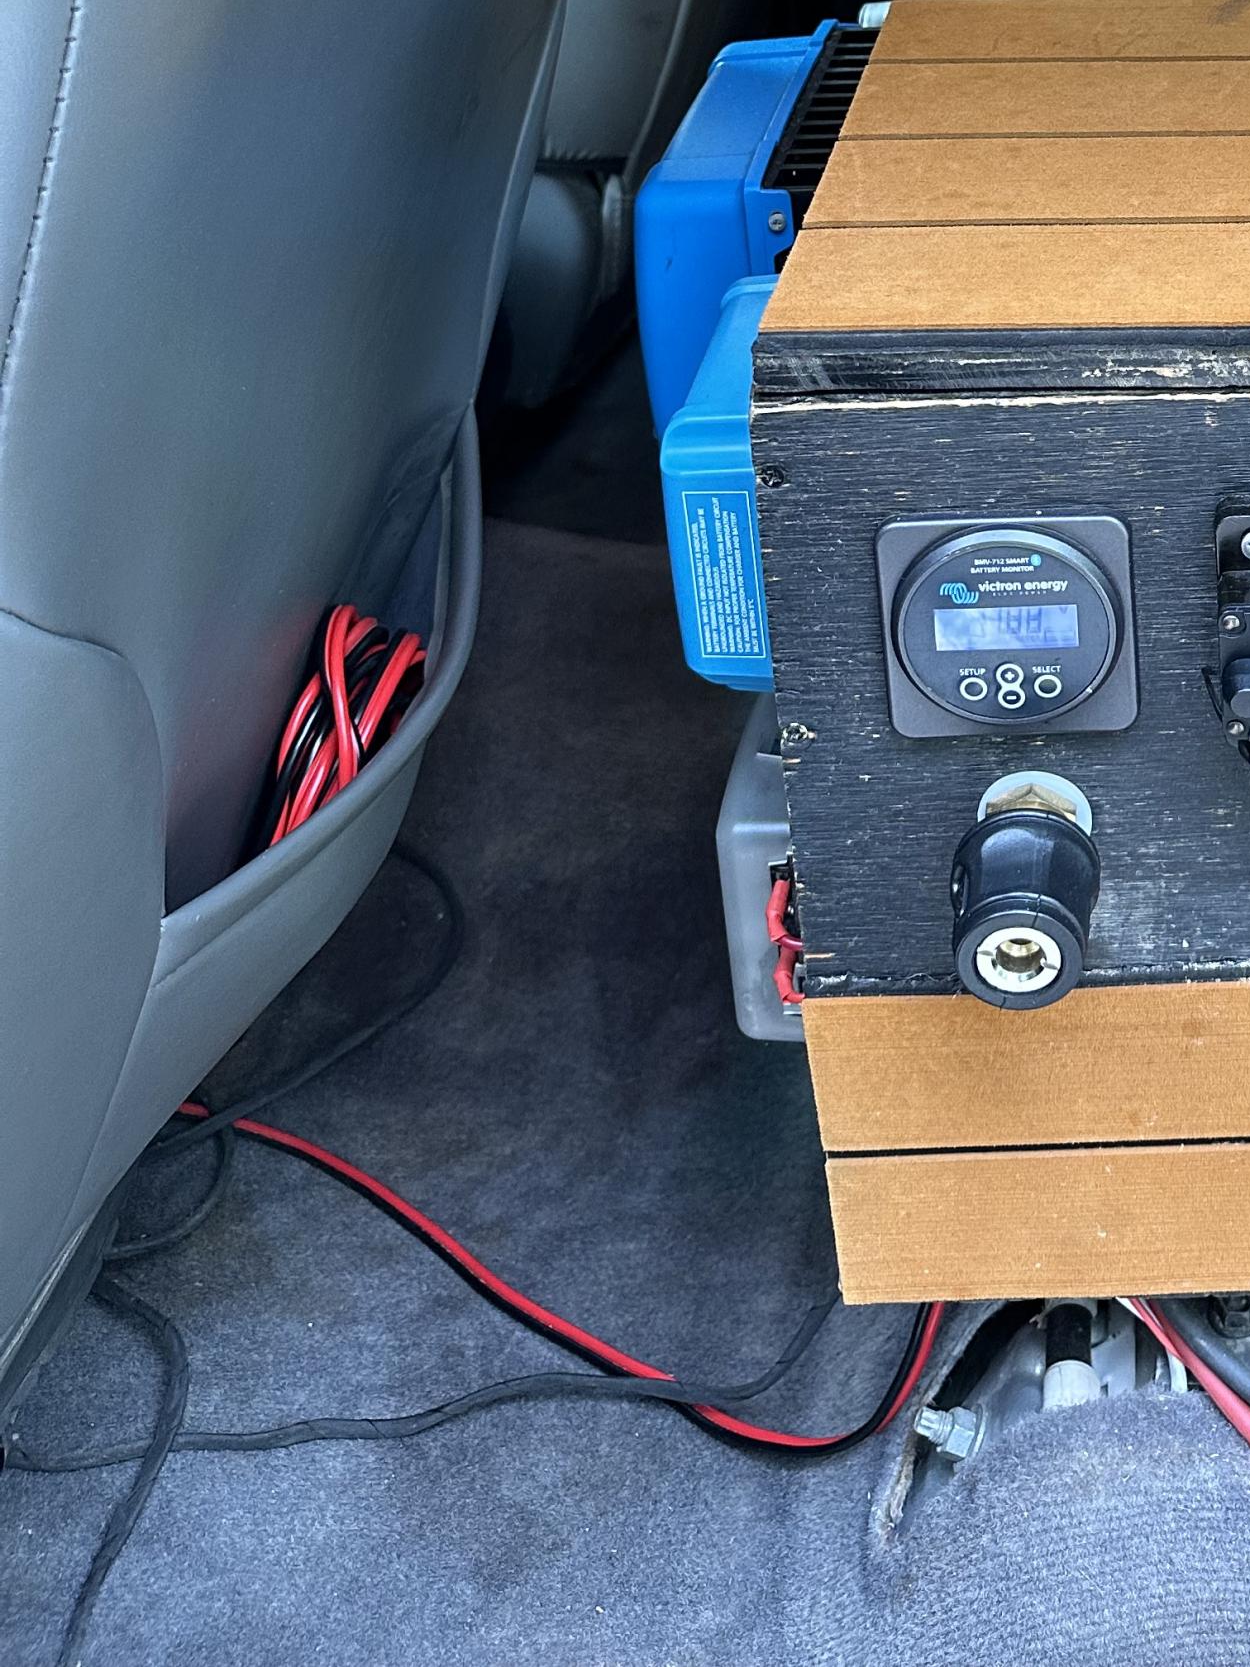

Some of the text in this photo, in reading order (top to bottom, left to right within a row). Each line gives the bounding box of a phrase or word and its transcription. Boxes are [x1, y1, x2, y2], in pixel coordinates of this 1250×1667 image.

[1005, 557, 1030, 565] SMART
[1001, 565, 1034, 573] MONITOR
[978, 579, 1068, 592] victron energy
[959, 668, 986, 676] SETUP
[1032, 665, 1061, 674] SELECT
